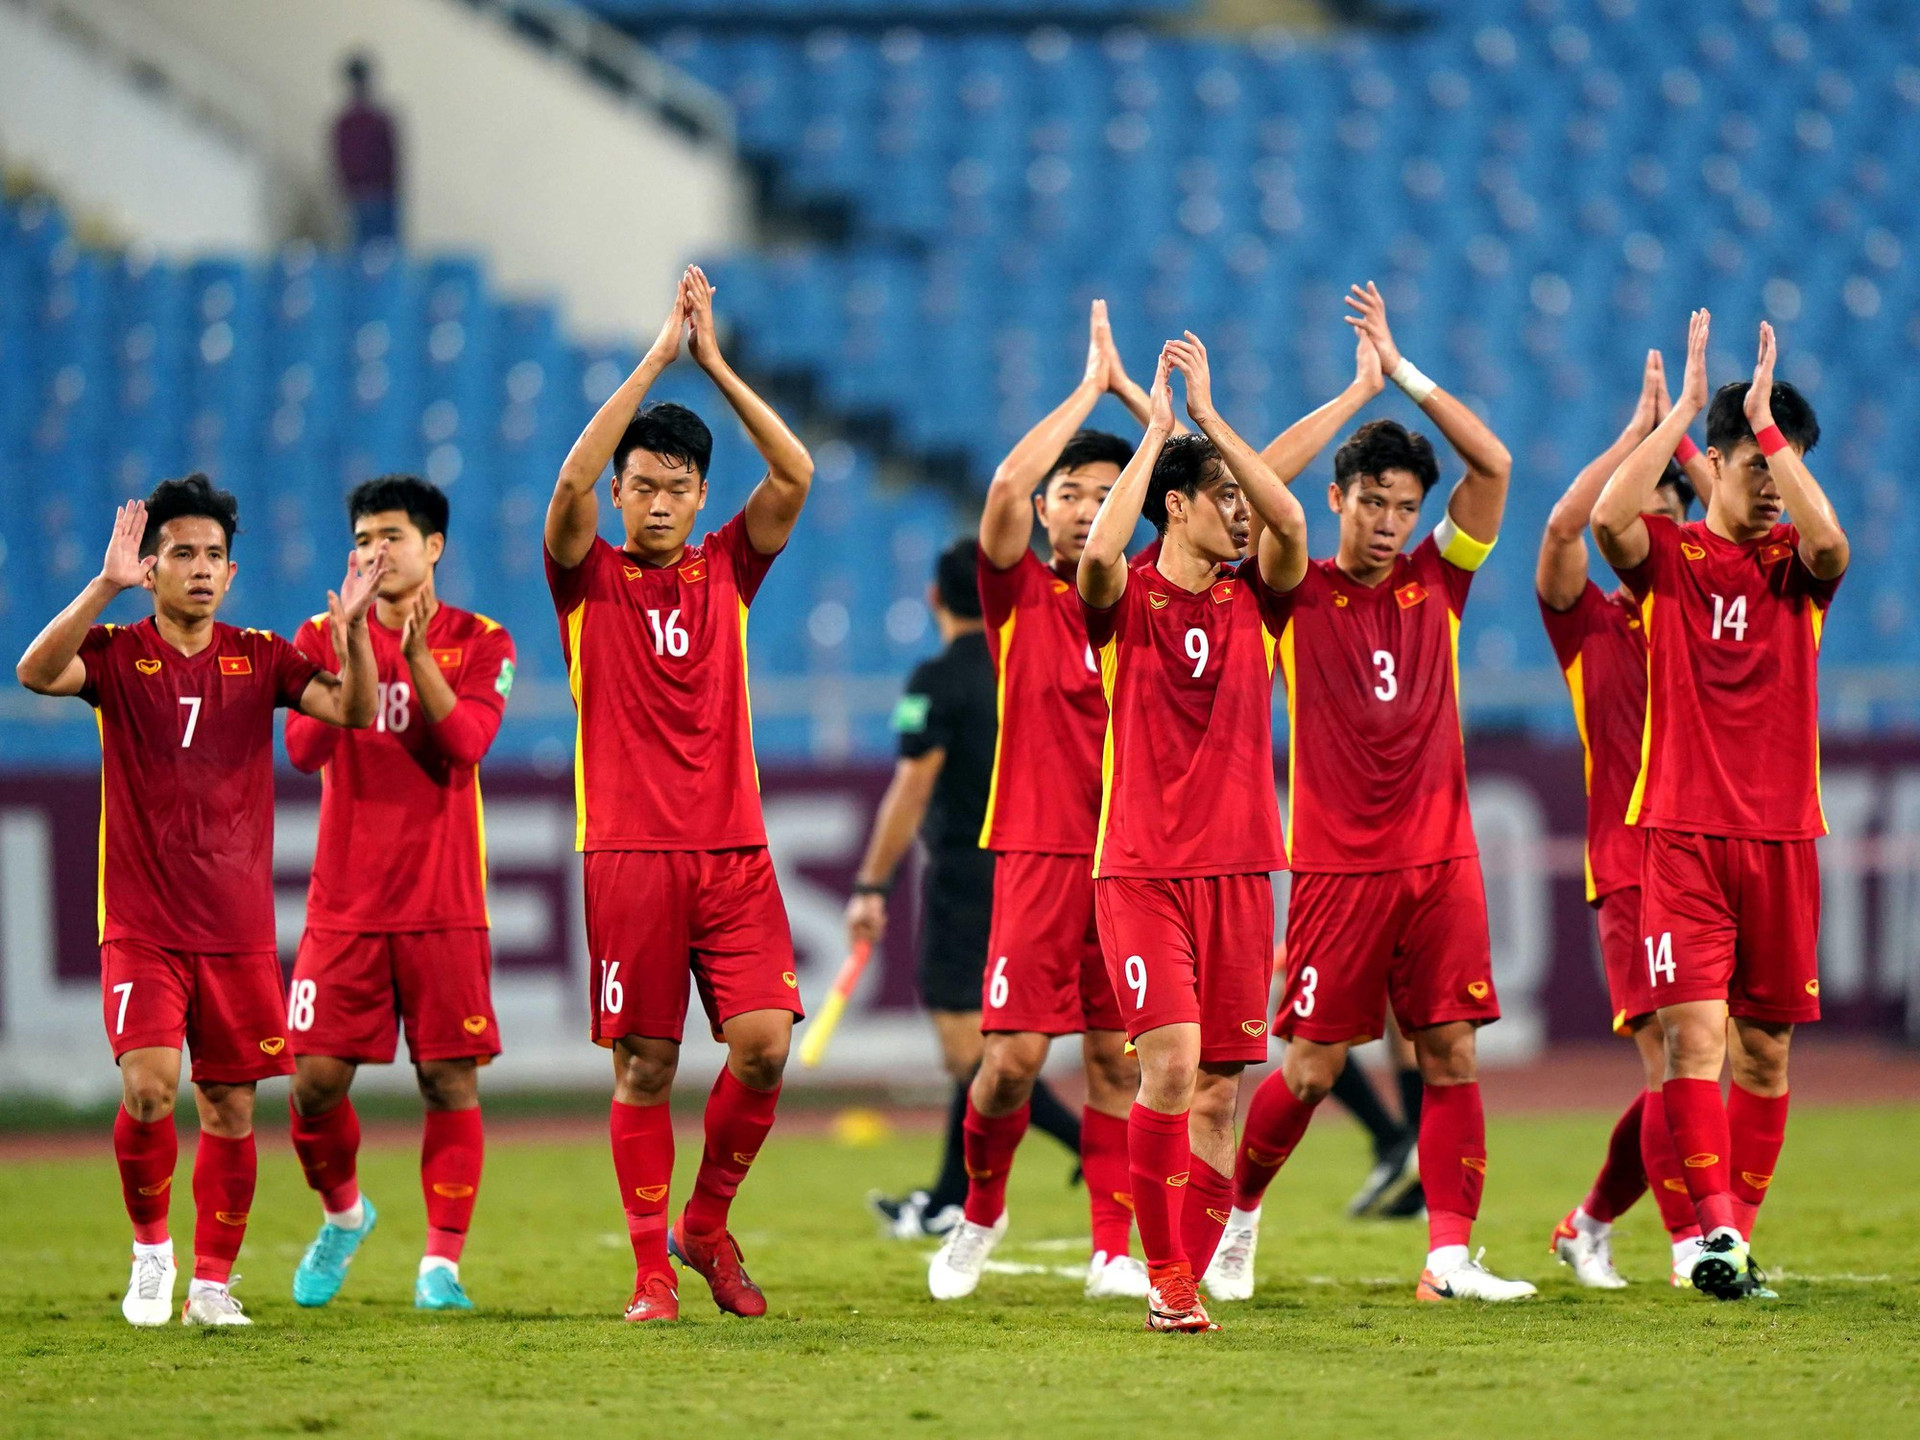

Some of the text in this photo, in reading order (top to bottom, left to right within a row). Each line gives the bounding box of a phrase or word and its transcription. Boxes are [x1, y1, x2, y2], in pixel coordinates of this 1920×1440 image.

[646, 608, 690, 657] 16
[1710, 593, 1748, 642] 14
[1184, 627, 1210, 678] 9
[1372, 649, 1398, 702] 3
[178, 696, 202, 748] 7
[376, 681, 411, 733] 18
[601, 957, 624, 1014] 16
[988, 956, 1009, 1009] 6
[1124, 955, 1148, 1010] 9
[1645, 931, 1677, 988] 14
[112, 981, 134, 1035] 7
[287, 978, 317, 1032] 18
[1293, 965, 1319, 1018] 3
